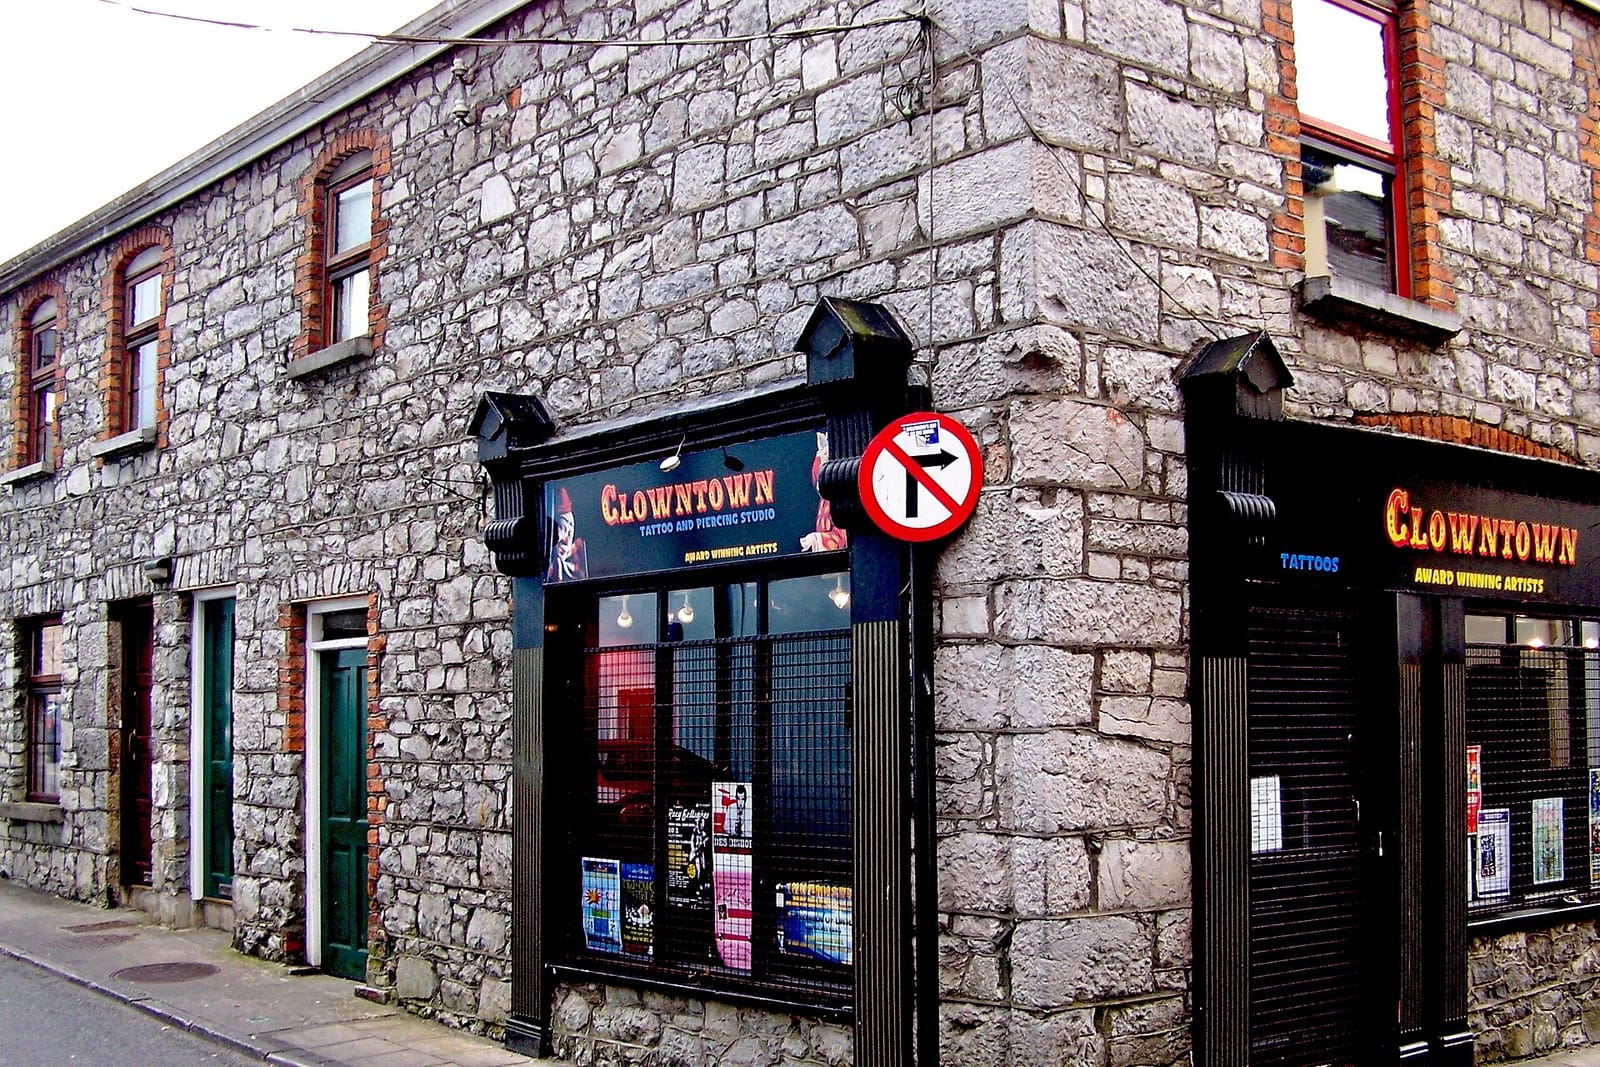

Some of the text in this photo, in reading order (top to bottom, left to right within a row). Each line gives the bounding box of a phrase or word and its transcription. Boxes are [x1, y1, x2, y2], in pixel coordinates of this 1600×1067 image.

[639, 508, 776, 537] TATTOO AND PIERCING STUDIO
[685, 542, 778, 564] AWARD WINNING ARTISTS
[1280, 552, 1339, 573] TATTOOS
[1414, 567, 1544, 593] AWARD WINNING ARTISTS
